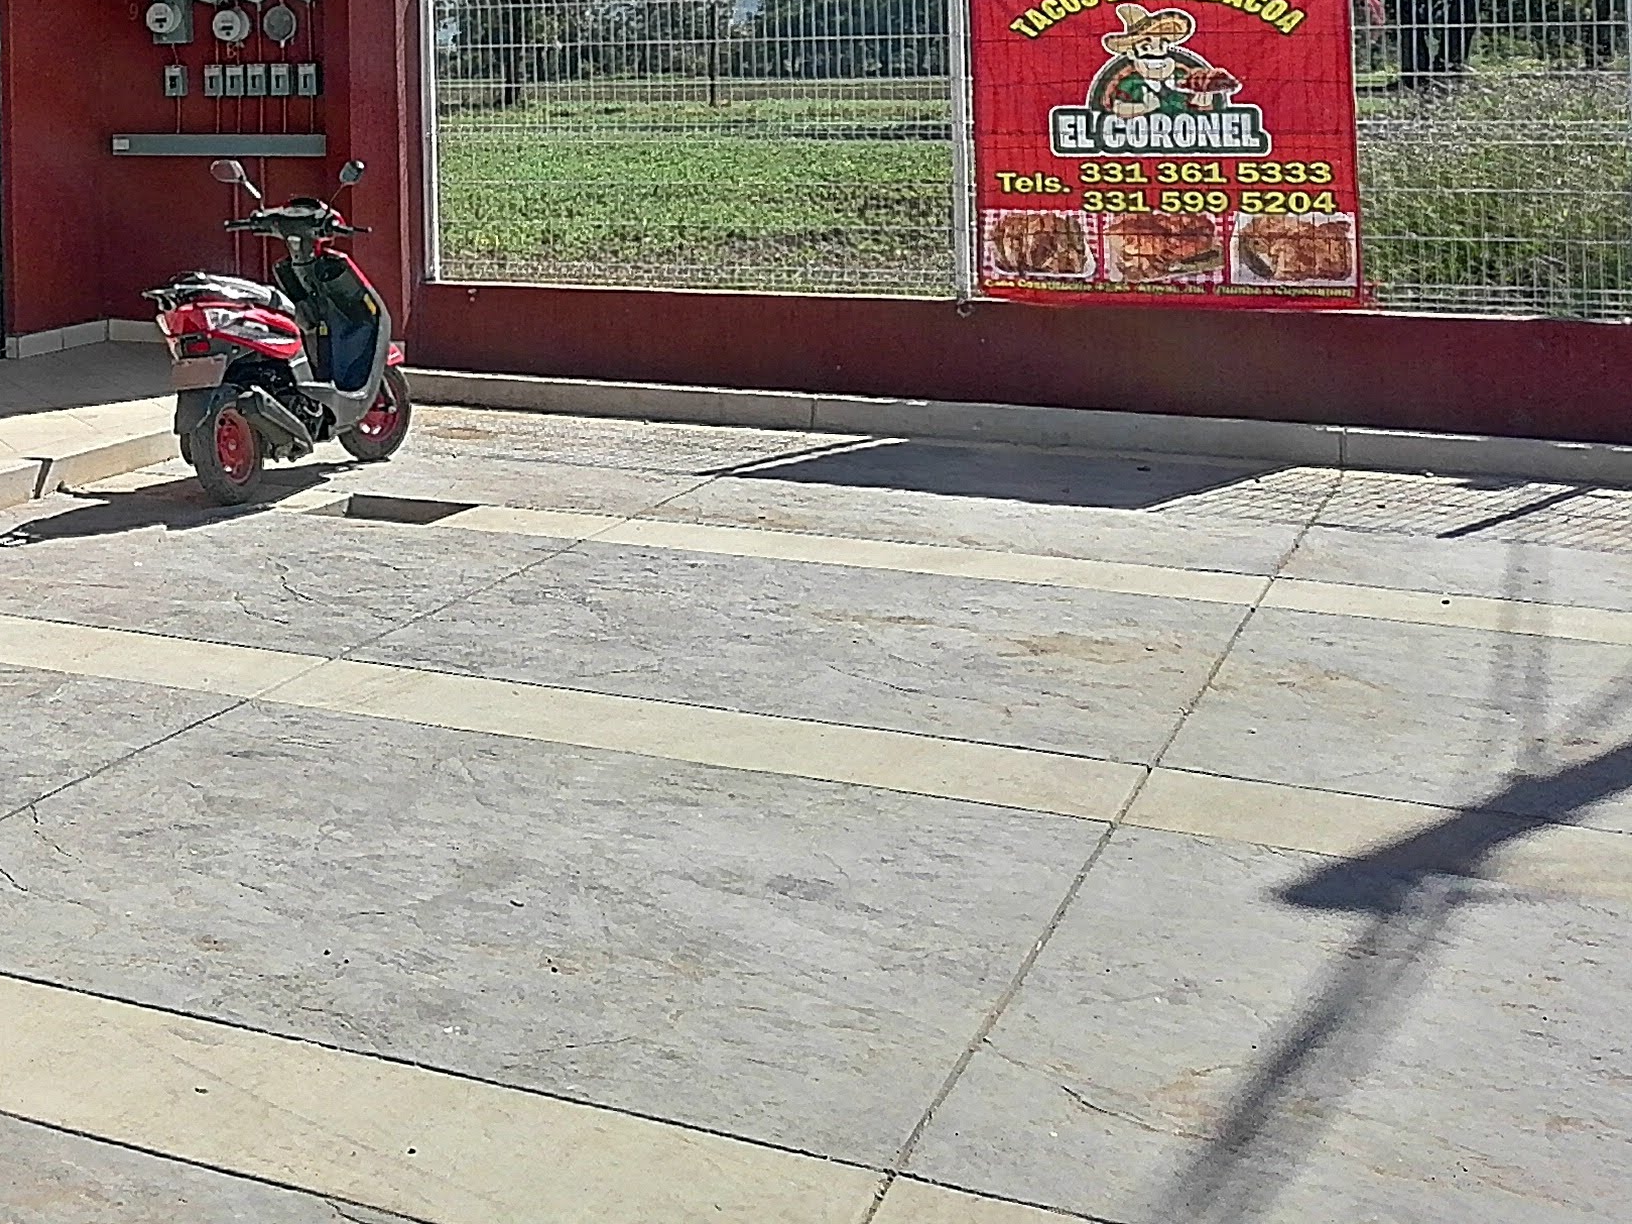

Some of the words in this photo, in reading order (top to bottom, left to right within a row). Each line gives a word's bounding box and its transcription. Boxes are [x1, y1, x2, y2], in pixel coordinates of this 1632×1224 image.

[1058, 113, 1093, 148] EL
[1103, 113, 1260, 149] CORONEL
[997, 171, 1072, 195] Tels.
[1079, 162, 1147, 185] 331
[1155, 162, 1228, 185] 361
[1237, 162, 1332, 185] 5333
[1082, 191, 1151, 214] 331
[1160, 191, 1229, 214] 599
[1239, 191, 1337, 214] 5204
